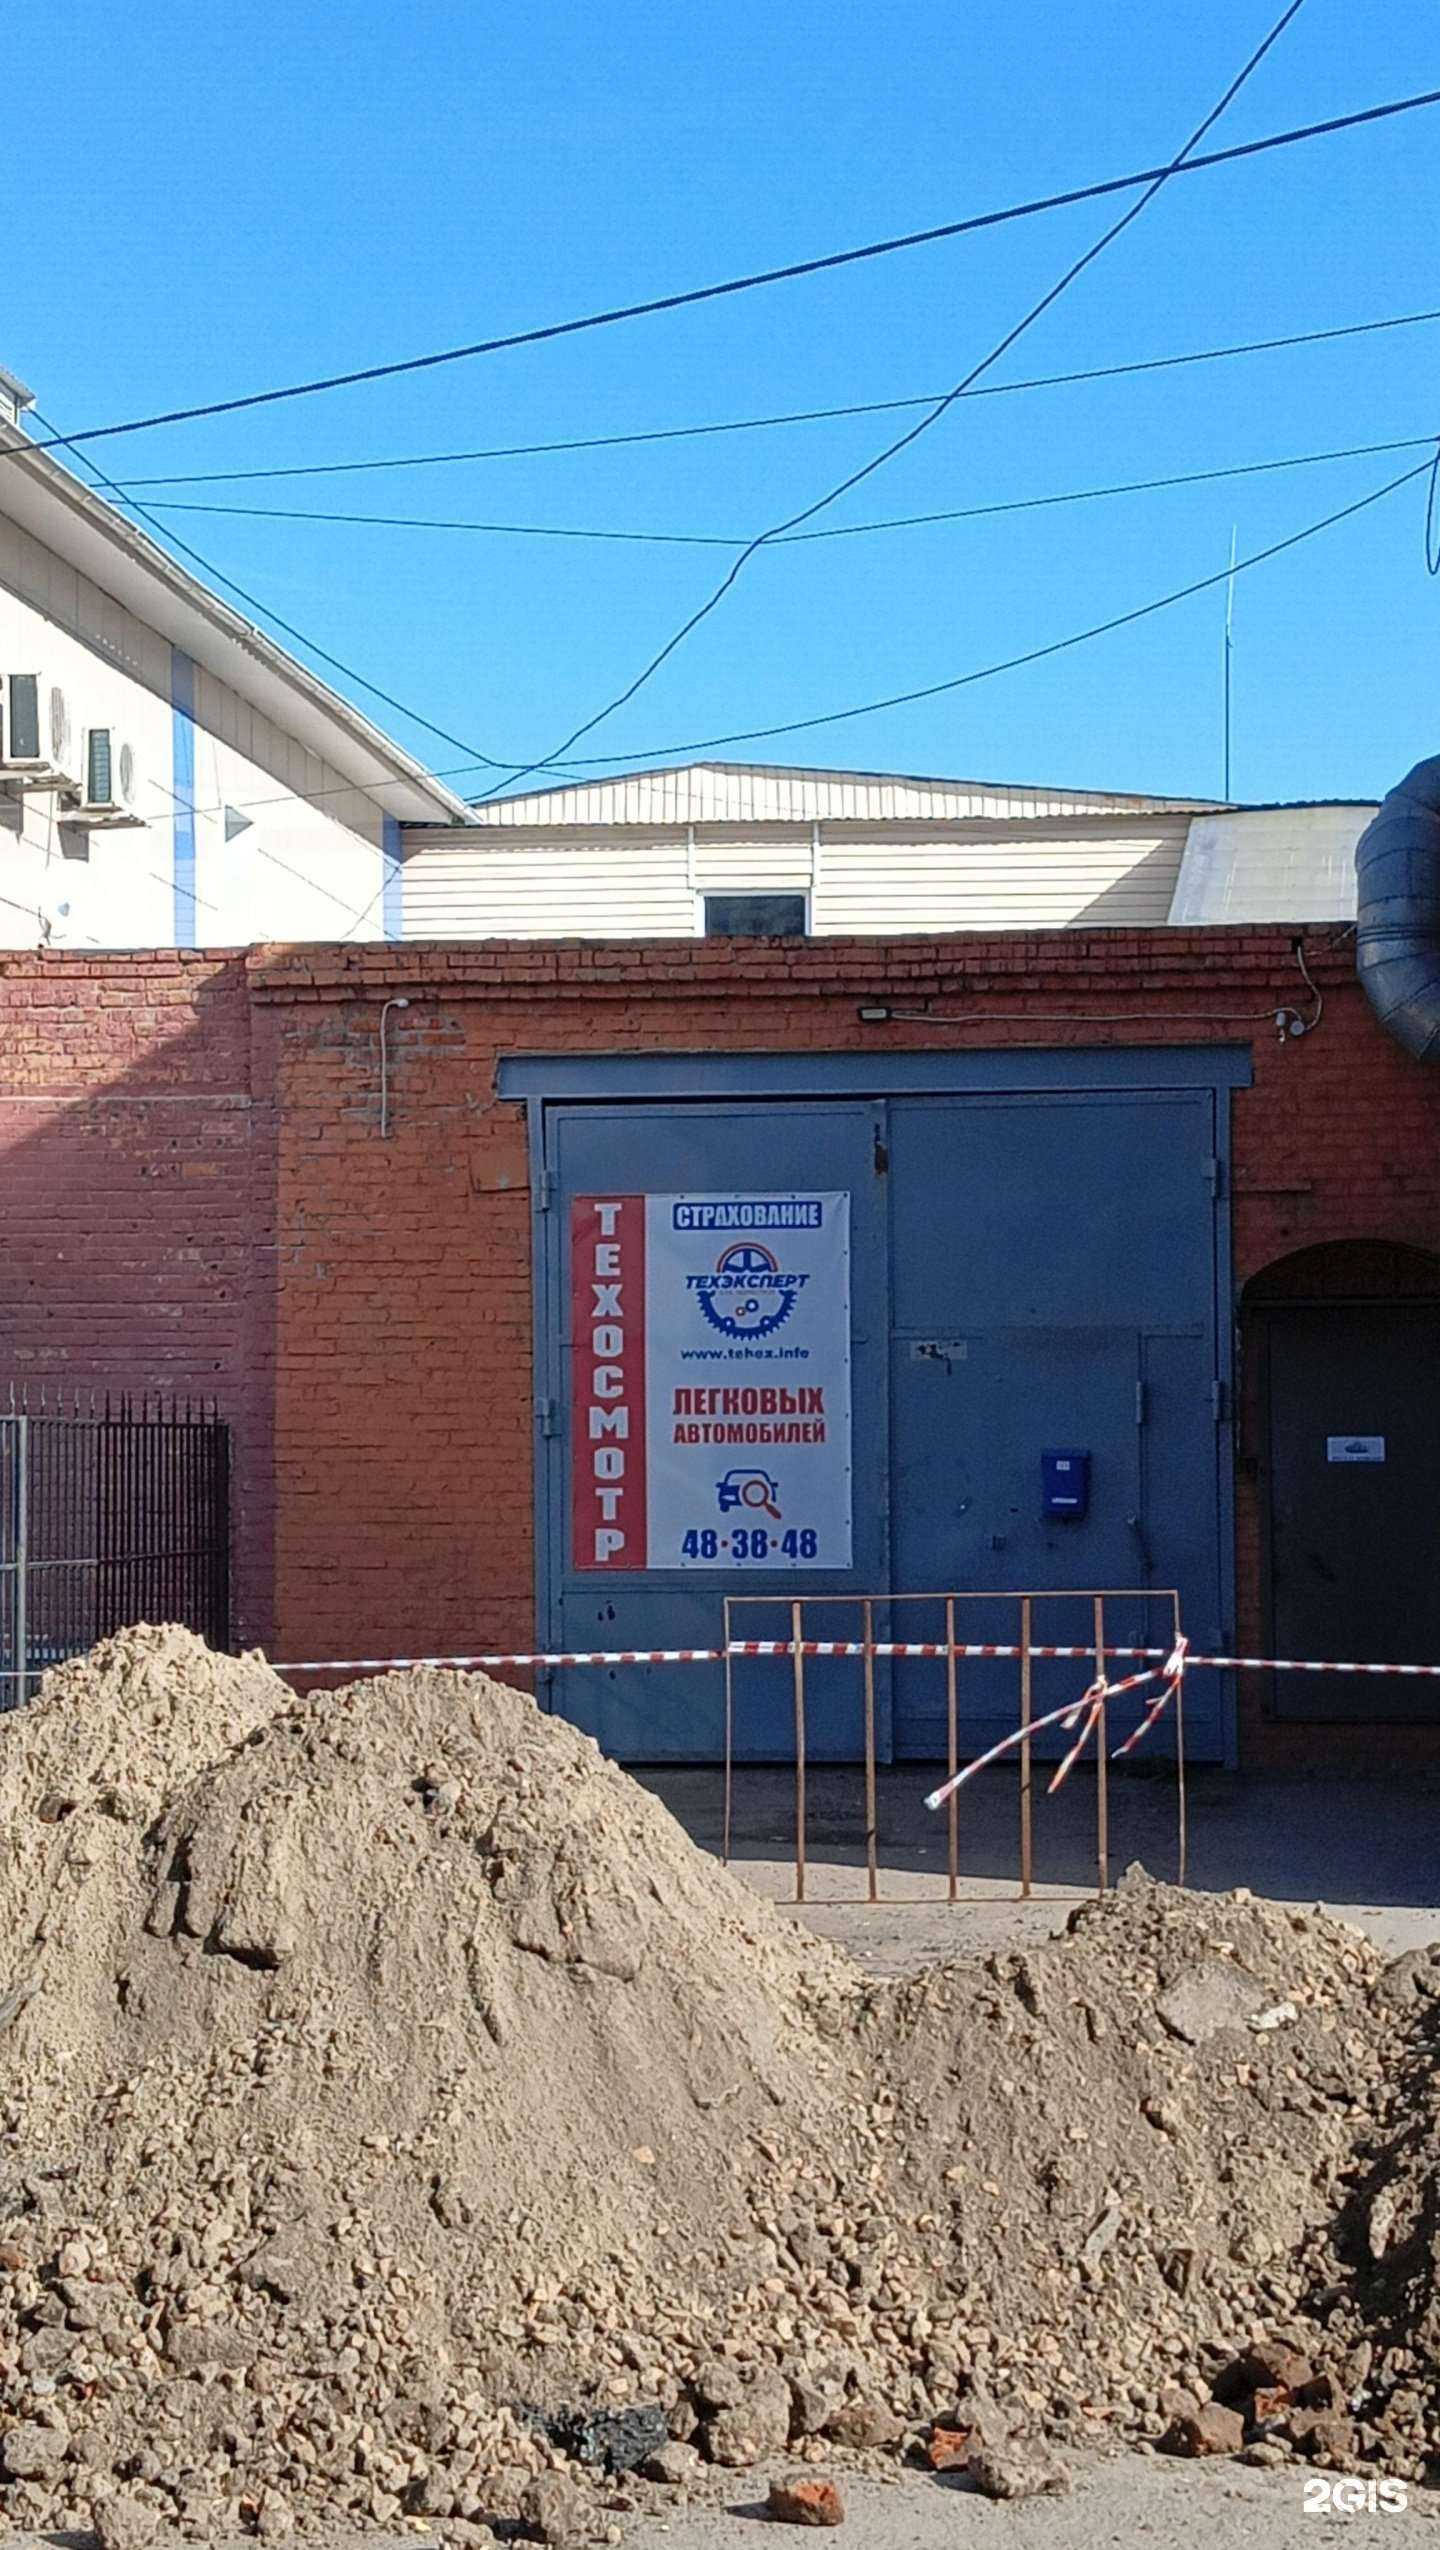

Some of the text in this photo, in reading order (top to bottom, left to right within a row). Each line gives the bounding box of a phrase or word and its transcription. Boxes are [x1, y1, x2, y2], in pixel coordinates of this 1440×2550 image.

[676, 1204, 819, 1228] СТРАХОВАНИЕ
[686, 1274, 810, 1289] ТЕХЭКСПЕРТ
[680, 1347, 809, 1360] www.tehex.info
[589, 1203, 629, 1562] ТЕХОСМОТР
[673, 1388, 824, 1415] ЛЕГКОВЫХ
[673, 1418, 825, 1443] АВТОМОБИЛЕЙ
